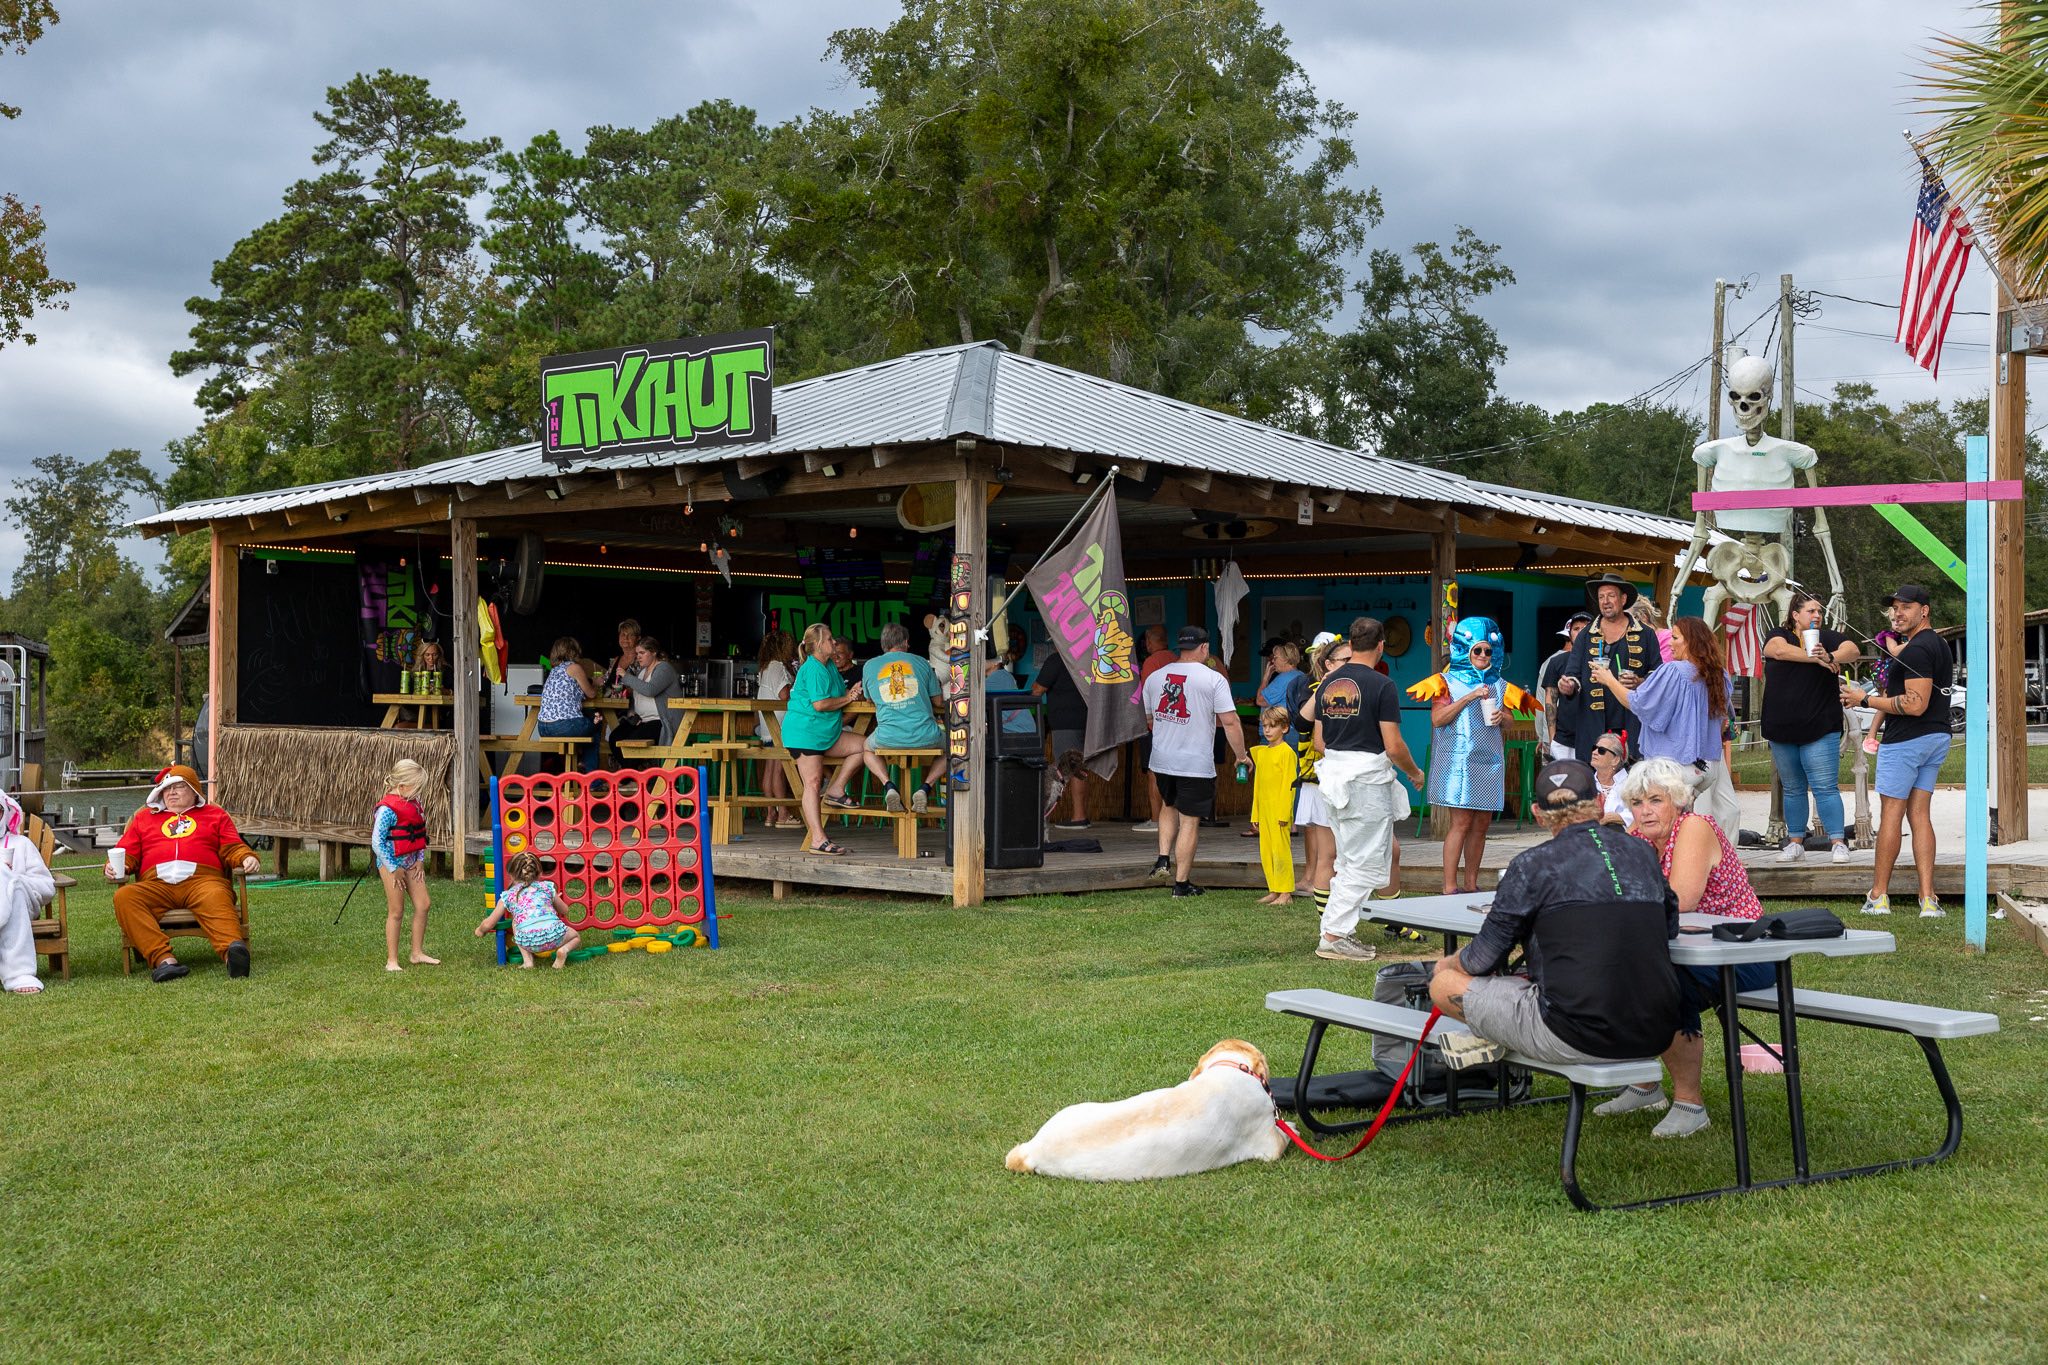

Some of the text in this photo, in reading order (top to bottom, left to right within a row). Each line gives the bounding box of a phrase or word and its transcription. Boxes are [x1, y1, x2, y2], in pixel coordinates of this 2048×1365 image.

[550, 402, 559, 447] THE
[649, 348, 765, 438] HUT
[839, 599, 911, 644] HUT
[1042, 571, 1097, 660] HUT
[1588, 828, 1623, 896] Huk Fishing
